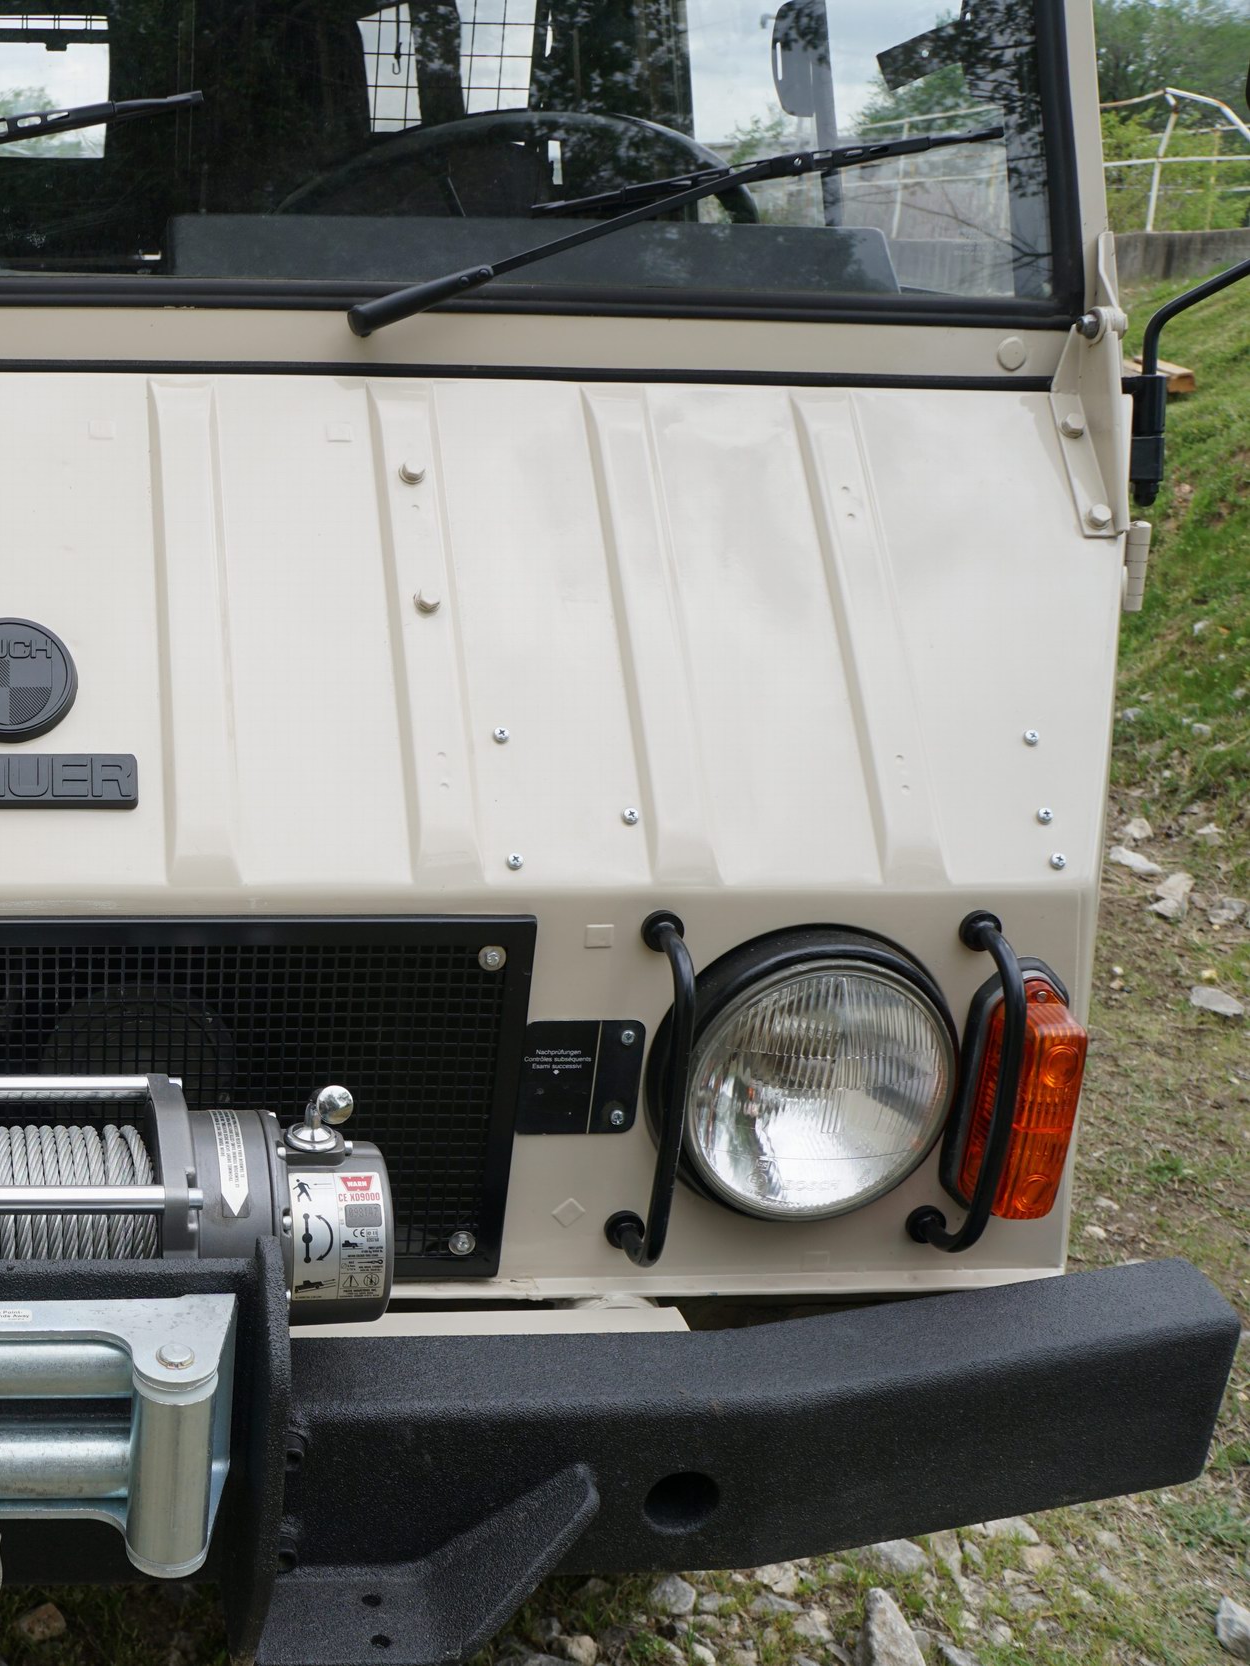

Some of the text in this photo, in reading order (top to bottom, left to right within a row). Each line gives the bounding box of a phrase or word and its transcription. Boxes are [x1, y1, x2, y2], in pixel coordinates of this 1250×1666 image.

[535, 1049, 582, 1057] Nachprüfungen
[346, 1180, 368, 1188] WARN
[350, 1192, 381, 1202] XD9000
